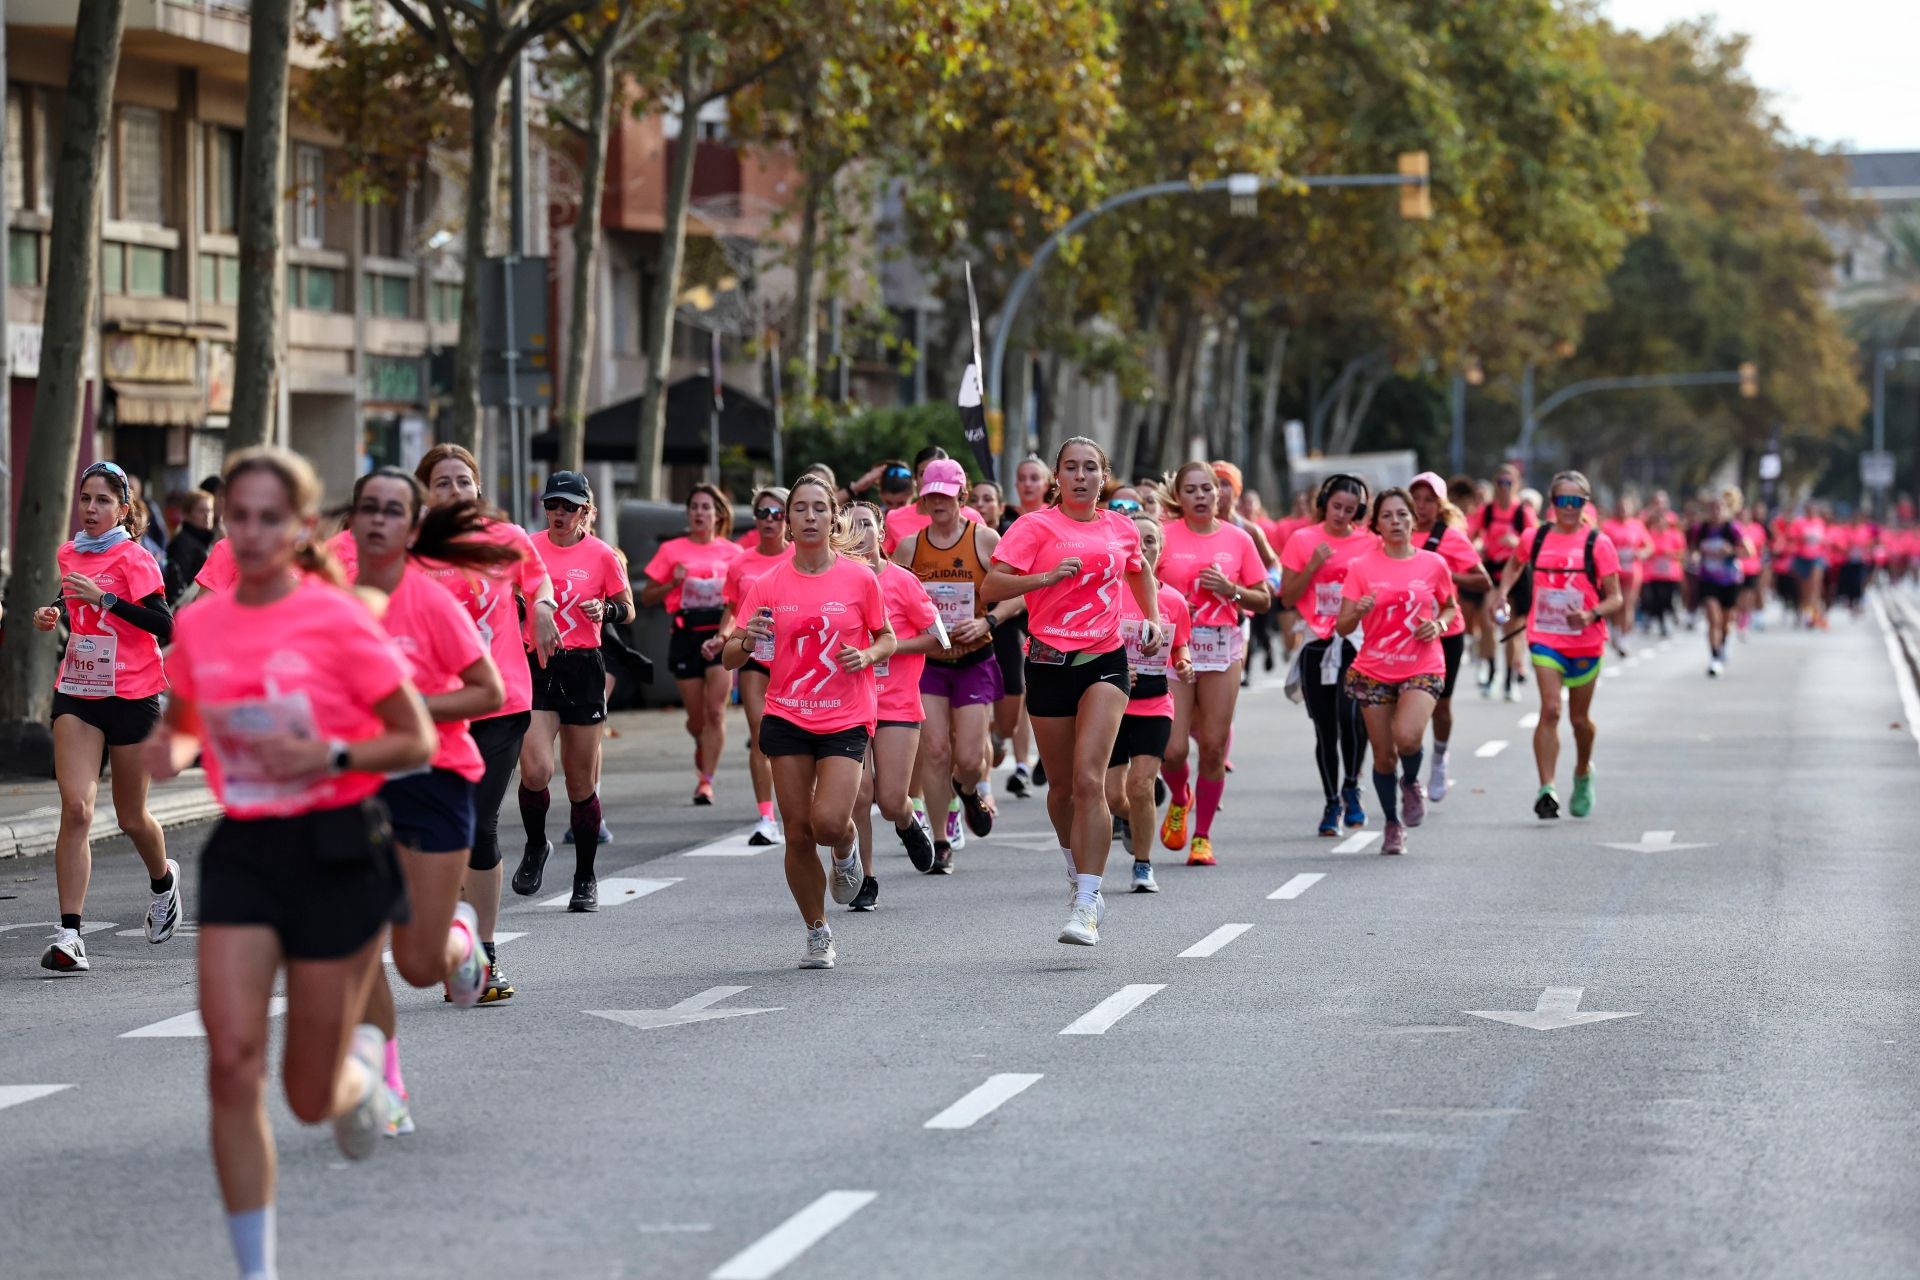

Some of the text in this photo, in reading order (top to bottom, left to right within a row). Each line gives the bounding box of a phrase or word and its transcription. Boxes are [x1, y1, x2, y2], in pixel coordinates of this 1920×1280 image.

[1056, 541, 1086, 549] OYSHO
[1043, 626, 1069, 637] CARRERA
[1193, 643, 1214, 652] 016
[75, 659, 94, 671] 016
[800, 699, 809, 708] DE
[809, 700, 818, 708] LA
[819, 699, 841, 708] MUJER
